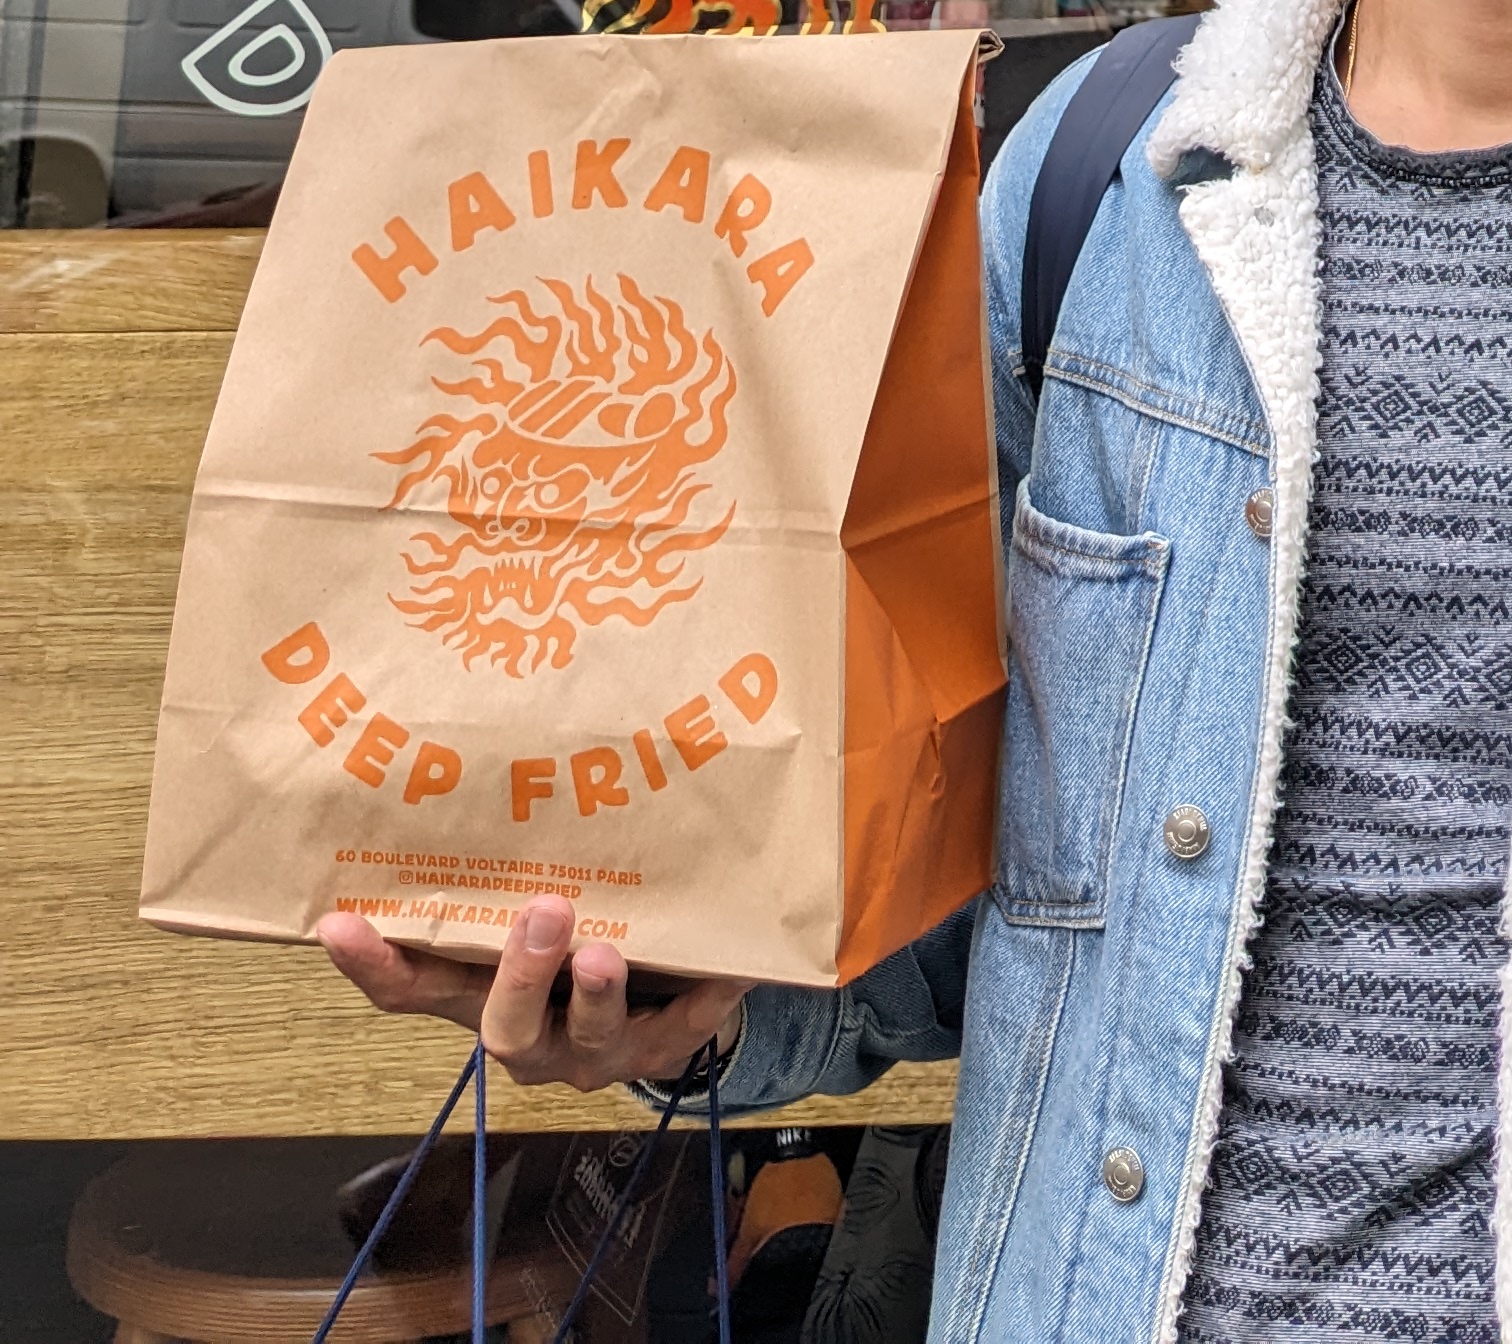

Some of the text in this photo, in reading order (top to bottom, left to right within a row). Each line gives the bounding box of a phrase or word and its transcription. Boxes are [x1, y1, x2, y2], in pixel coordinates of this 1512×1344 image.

[350, 136, 815, 318] HAIKARA
[260, 620, 779, 822] DEEP FRIED
[335, 849, 643, 886] 60 BOULEVARD VOLTAIRE 75011 PARIS
